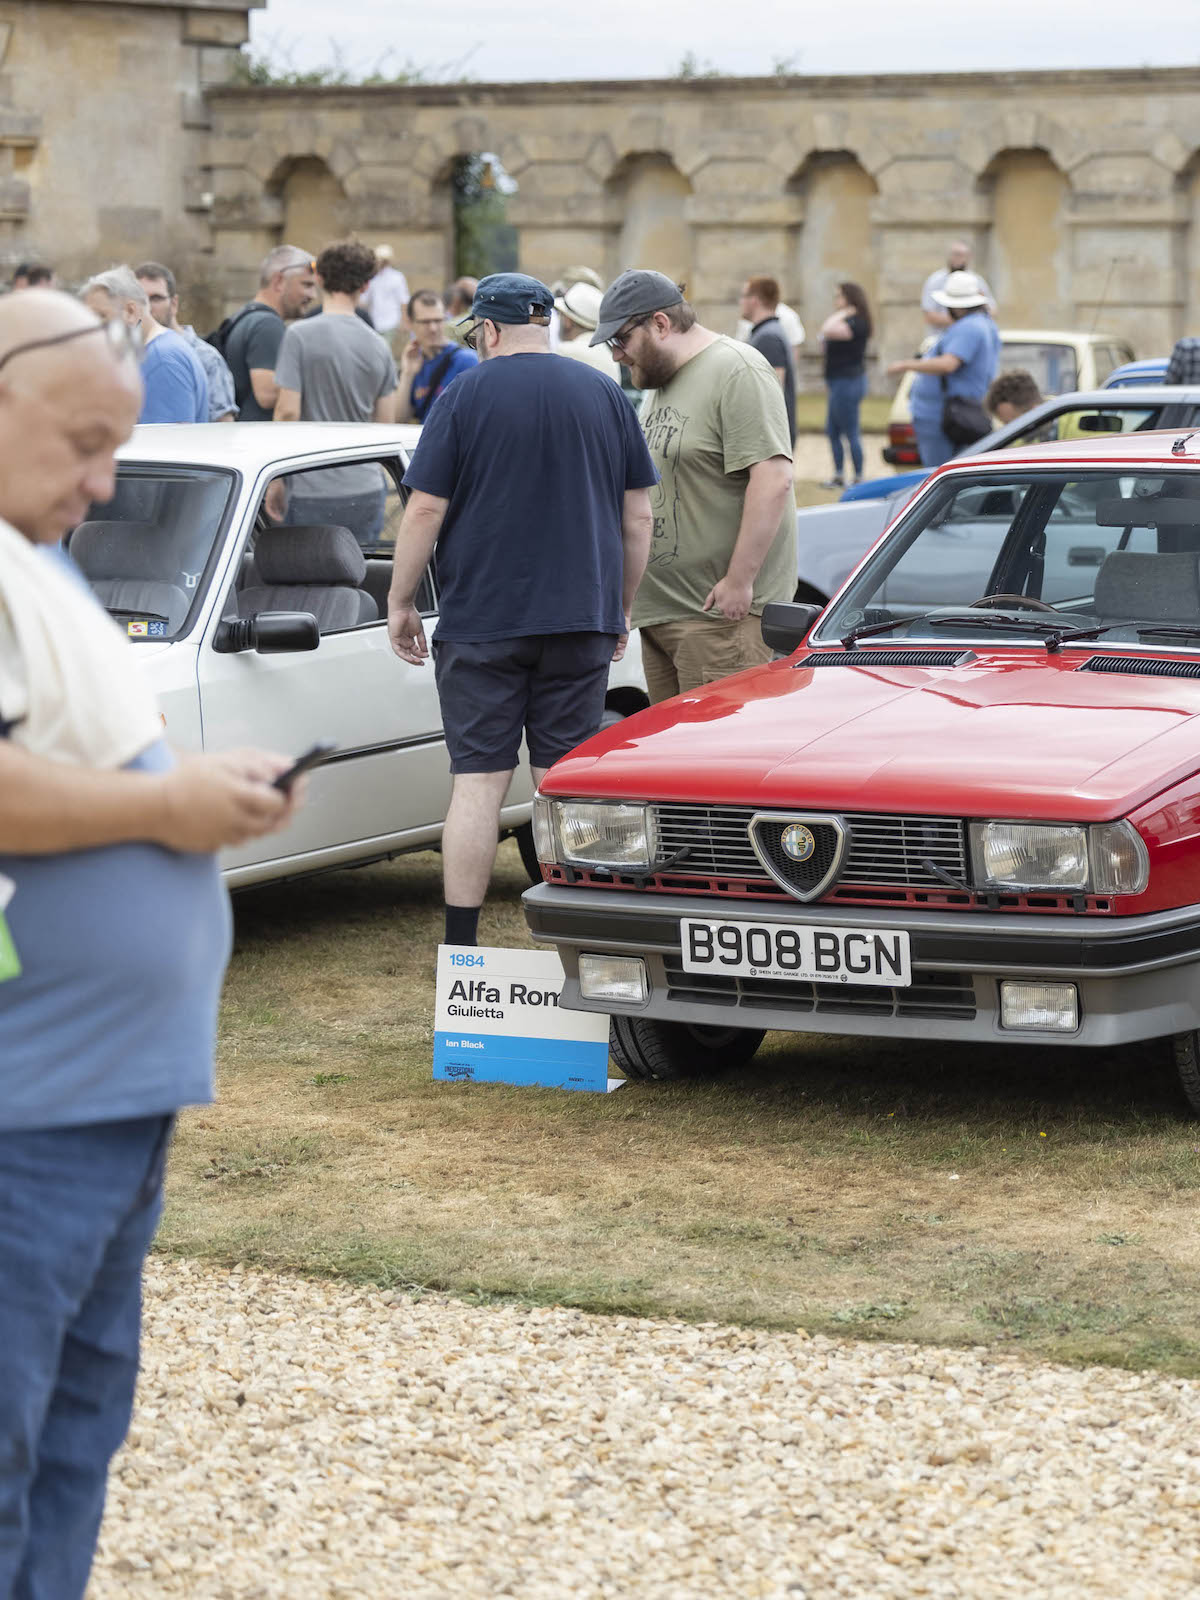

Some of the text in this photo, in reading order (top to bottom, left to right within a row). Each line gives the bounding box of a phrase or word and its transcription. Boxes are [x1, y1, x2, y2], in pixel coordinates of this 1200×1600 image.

[688, 923, 902, 976] B908 BGN
[449, 953, 486, 967] 1984
[448, 980, 501, 1004] Alfa
[447, 1004, 504, 1019] Giulietta
[445, 1039, 485, 1049] Ian Black
